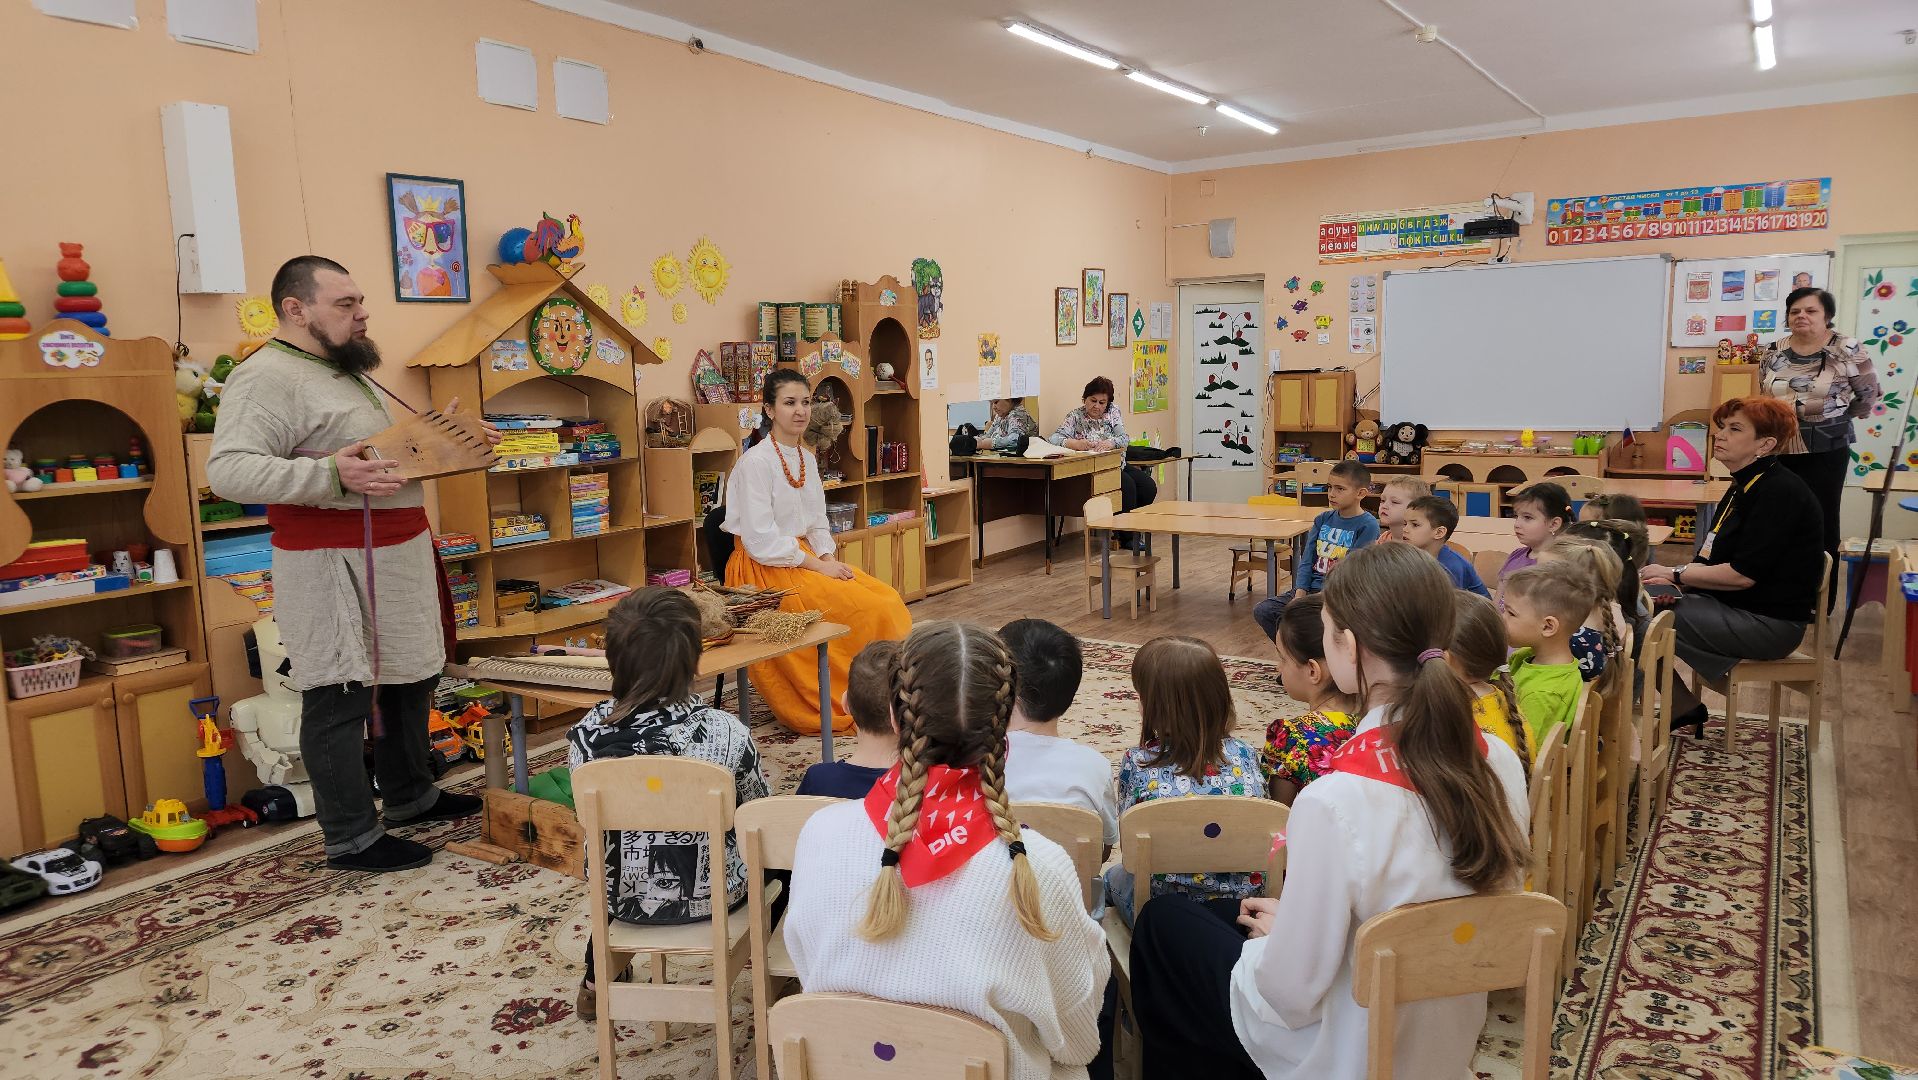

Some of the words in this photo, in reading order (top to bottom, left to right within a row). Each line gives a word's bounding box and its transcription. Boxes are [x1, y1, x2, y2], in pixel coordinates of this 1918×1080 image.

[1320, 228, 1326, 236] а
[1334, 226, 1341, 236] у
[1342, 226, 1349, 235] ы
[1351, 225, 1356, 233] э
[1391, 222, 1397, 232] р
[1400, 218, 1405, 229] б
[1416, 220, 1421, 228] г
[1424, 219, 1431, 229] д
[1439, 218, 1448, 226] ж
[1549, 230, 1559, 243] 0
[1562, 230, 1569, 242] 1
[1573, 229, 1583, 242] 2
[1586, 227, 1595, 241] 3
[1597, 226, 1608, 240] 4
[1611, 225, 1621, 238] 5
[1623, 224, 1634, 237] 6
[1636, 224, 1646, 237] 7
[1648, 222, 1659, 236] 8
[1662, 222, 1673, 236] 9
[1674, 221, 1686, 234] 10
[1687, 221, 1699, 234] 11
[1701, 220, 1714, 234] 12
[1715, 219, 1727, 232] 13
[1728, 218, 1741, 232] 14
[1743, 216, 1755, 230] 15
[1757, 216, 1769, 230] 16
[1770, 215, 1784, 228] 17
[1785, 214, 1797, 228] 18
[1800, 213, 1812, 227] 19
[1813, 212, 1827, 225] 20
[1320, 243, 1326, 251] я
[1328, 241, 1334, 250] ё
[1334, 242, 1342, 250] ю
[1399, 237, 1405, 245] п
[1406, 236, 1413, 247] ф
[1424, 235, 1430, 243] т
[1439, 234, 1448, 243] ш
